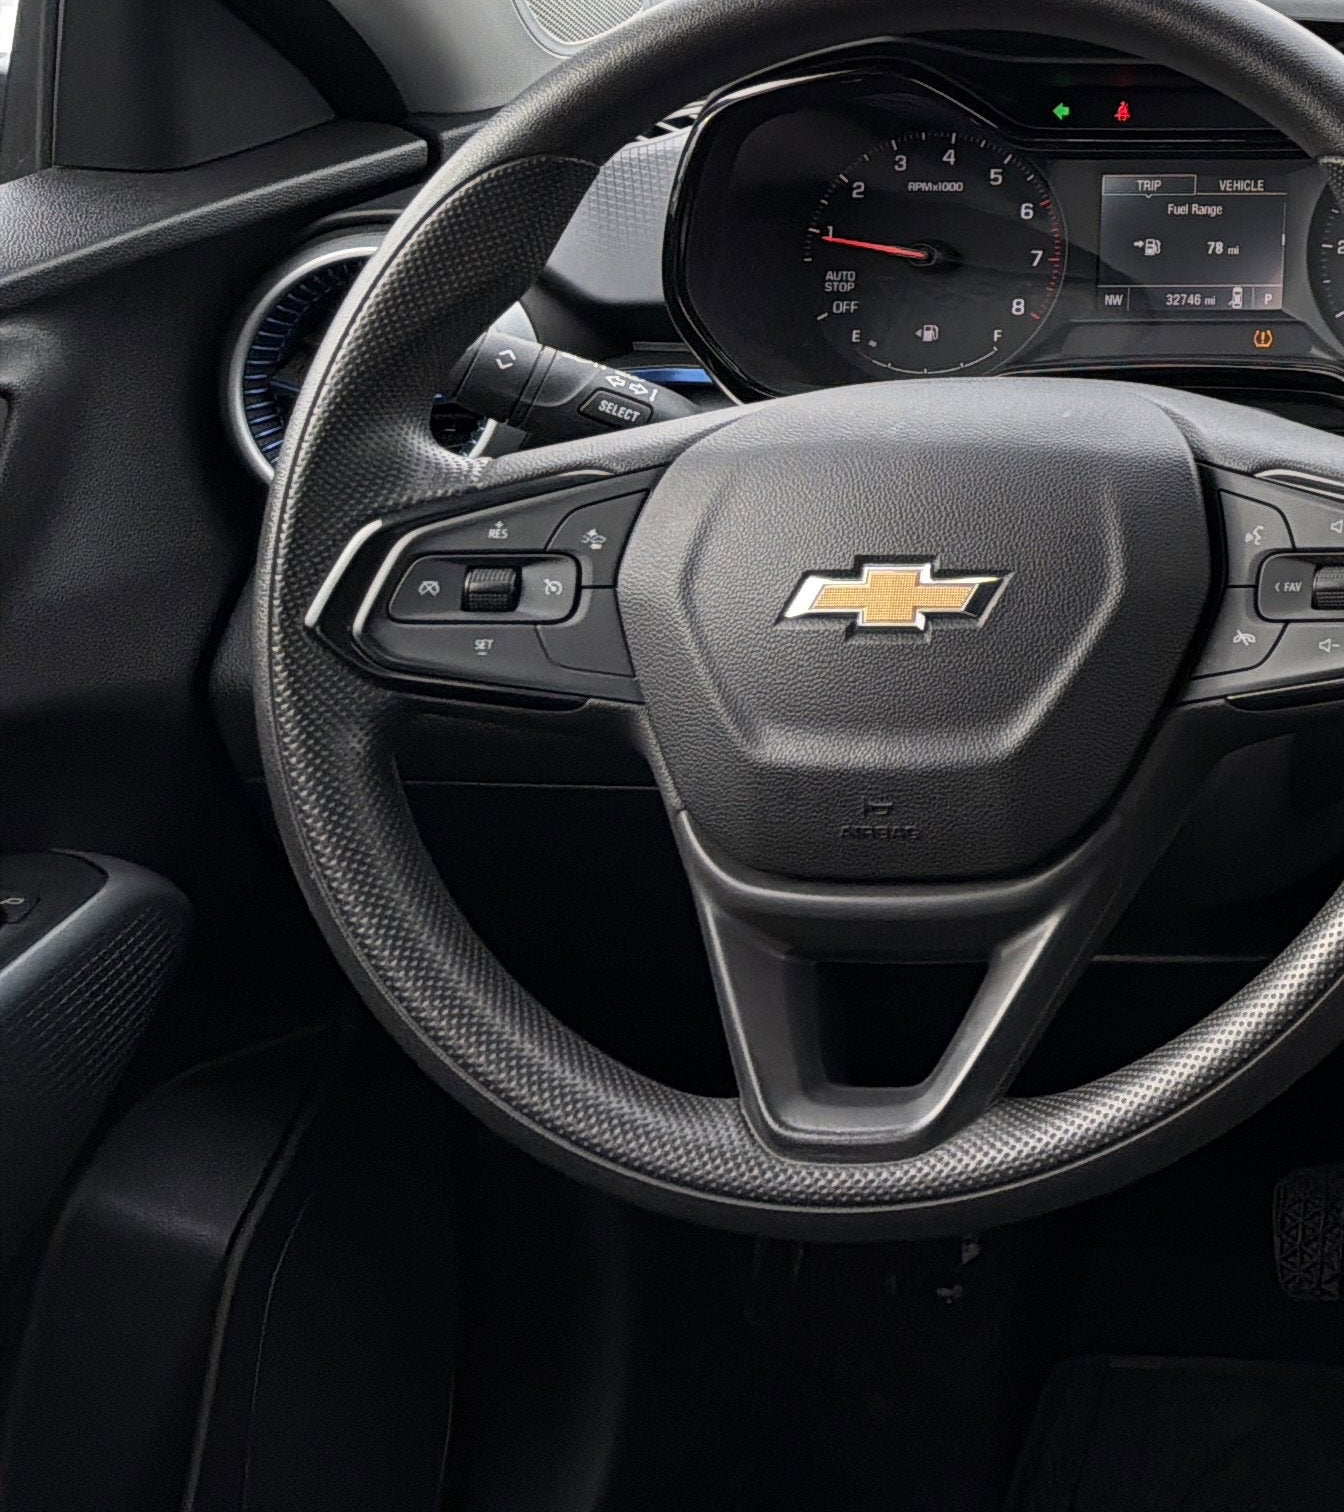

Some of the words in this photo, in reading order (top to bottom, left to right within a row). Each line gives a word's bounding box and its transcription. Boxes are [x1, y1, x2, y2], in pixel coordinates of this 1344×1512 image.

[893, 155, 907, 172] 3
[942, 149, 956, 166] 4
[989, 169, 1003, 186] 5
[852, 182, 865, 199] 2
[907, 181, 964, 193] RPMx1000
[1137, 180, 1162, 191] TRIP
[1219, 180, 1265, 191] VEHICLE
[1020, 203, 1034, 220] 6
[1167, 203, 1189, 215] Fuel
[1192, 204, 1223, 217] Range
[1207, 241, 1224, 255] 78
[1228, 245, 1240, 255] mi
[1030, 250, 1043, 267] 7
[825, 270, 856, 282] AUTO
[825, 281, 855, 293] STOP
[1104, 294, 1124, 306] NW
[1165, 294, 1202, 306] 32746
[1204, 295, 1216, 306] mi
[1264, 294, 1272, 305] P
[832, 301, 859, 314] OFF
[1011, 298, 1025, 315] 8
[852, 330, 861, 343] E
[994, 329, 1003, 343] F
[597, 400, 640, 423] SELECT
[488, 529, 508, 539] RES
[1283, 581, 1302, 591] FAV
[474, 639, 494, 650] SET
